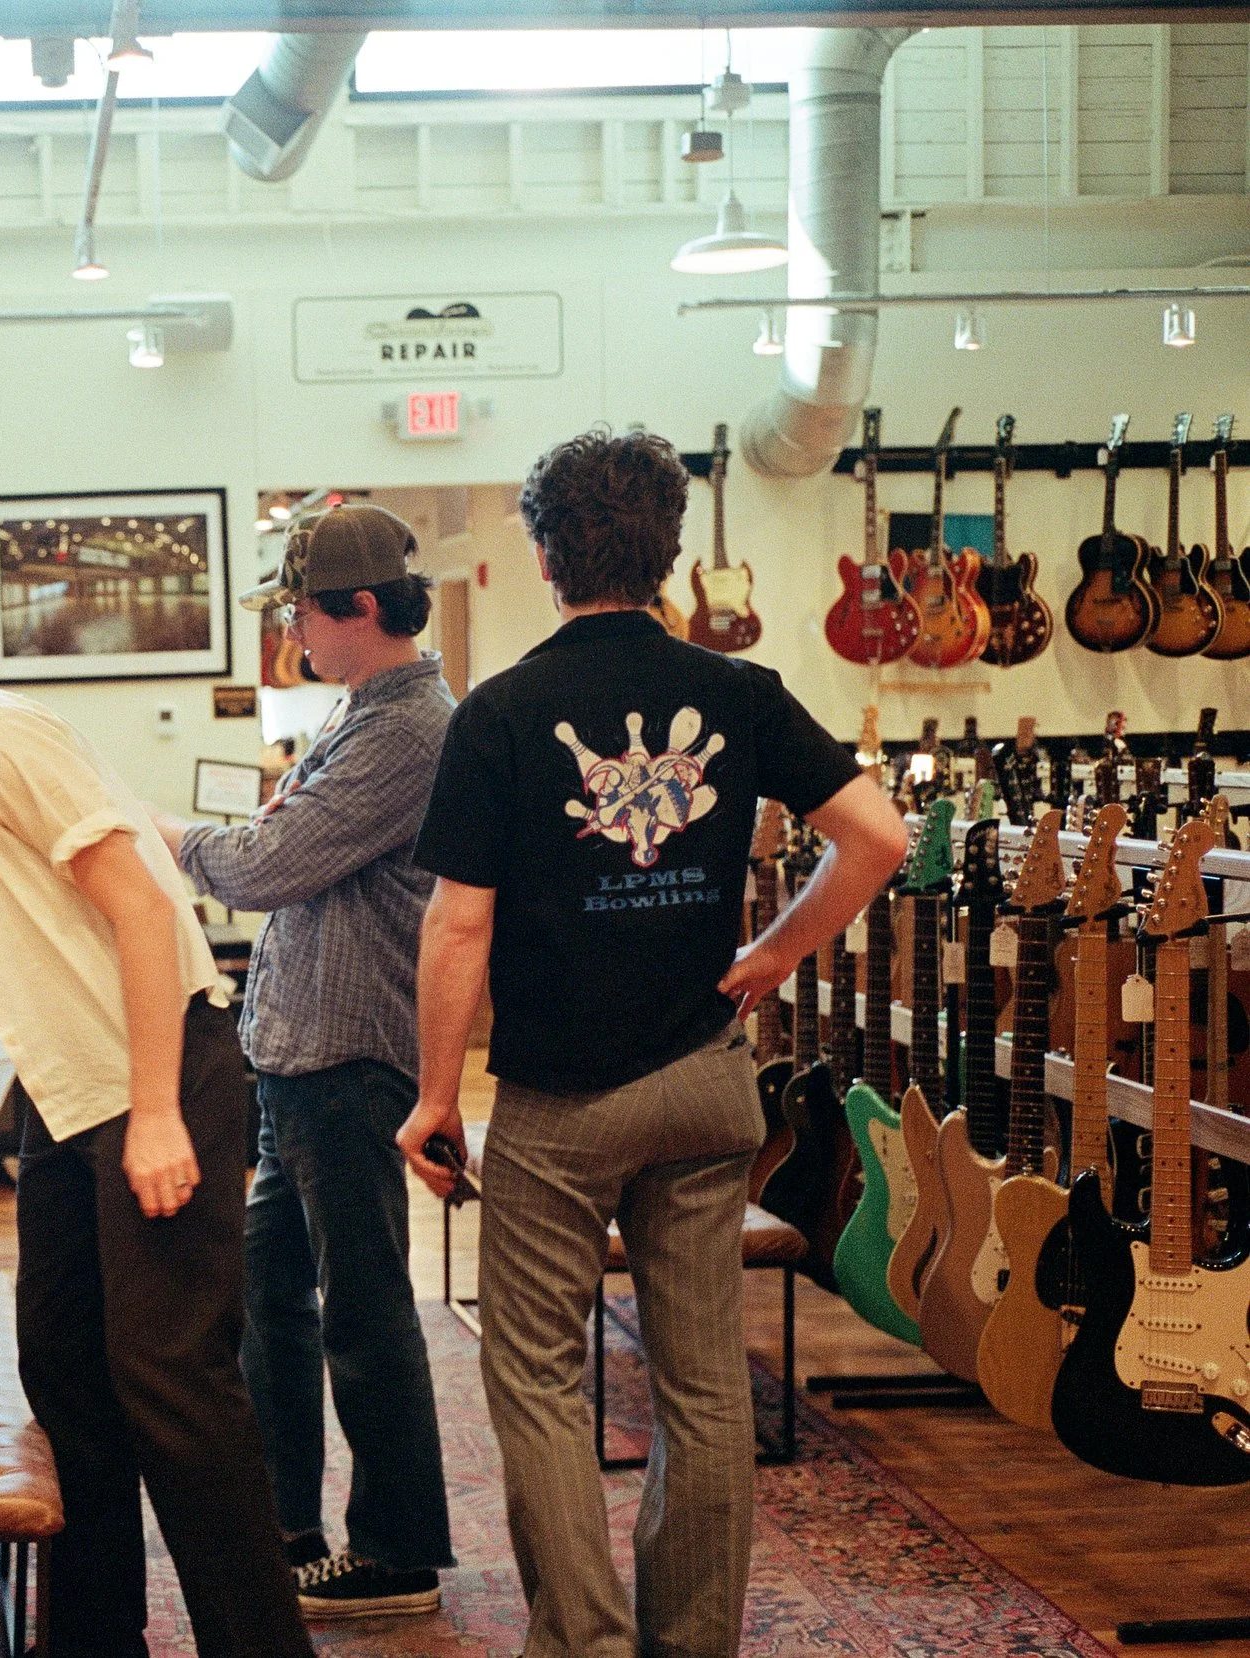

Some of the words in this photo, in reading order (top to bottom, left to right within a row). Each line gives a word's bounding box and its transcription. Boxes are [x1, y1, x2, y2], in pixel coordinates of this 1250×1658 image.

[380, 342, 476, 360] REPAIR
[408, 392, 458, 433] EXIT
[599, 867, 706, 890] LPMS
[584, 888, 721, 911] Bowling
